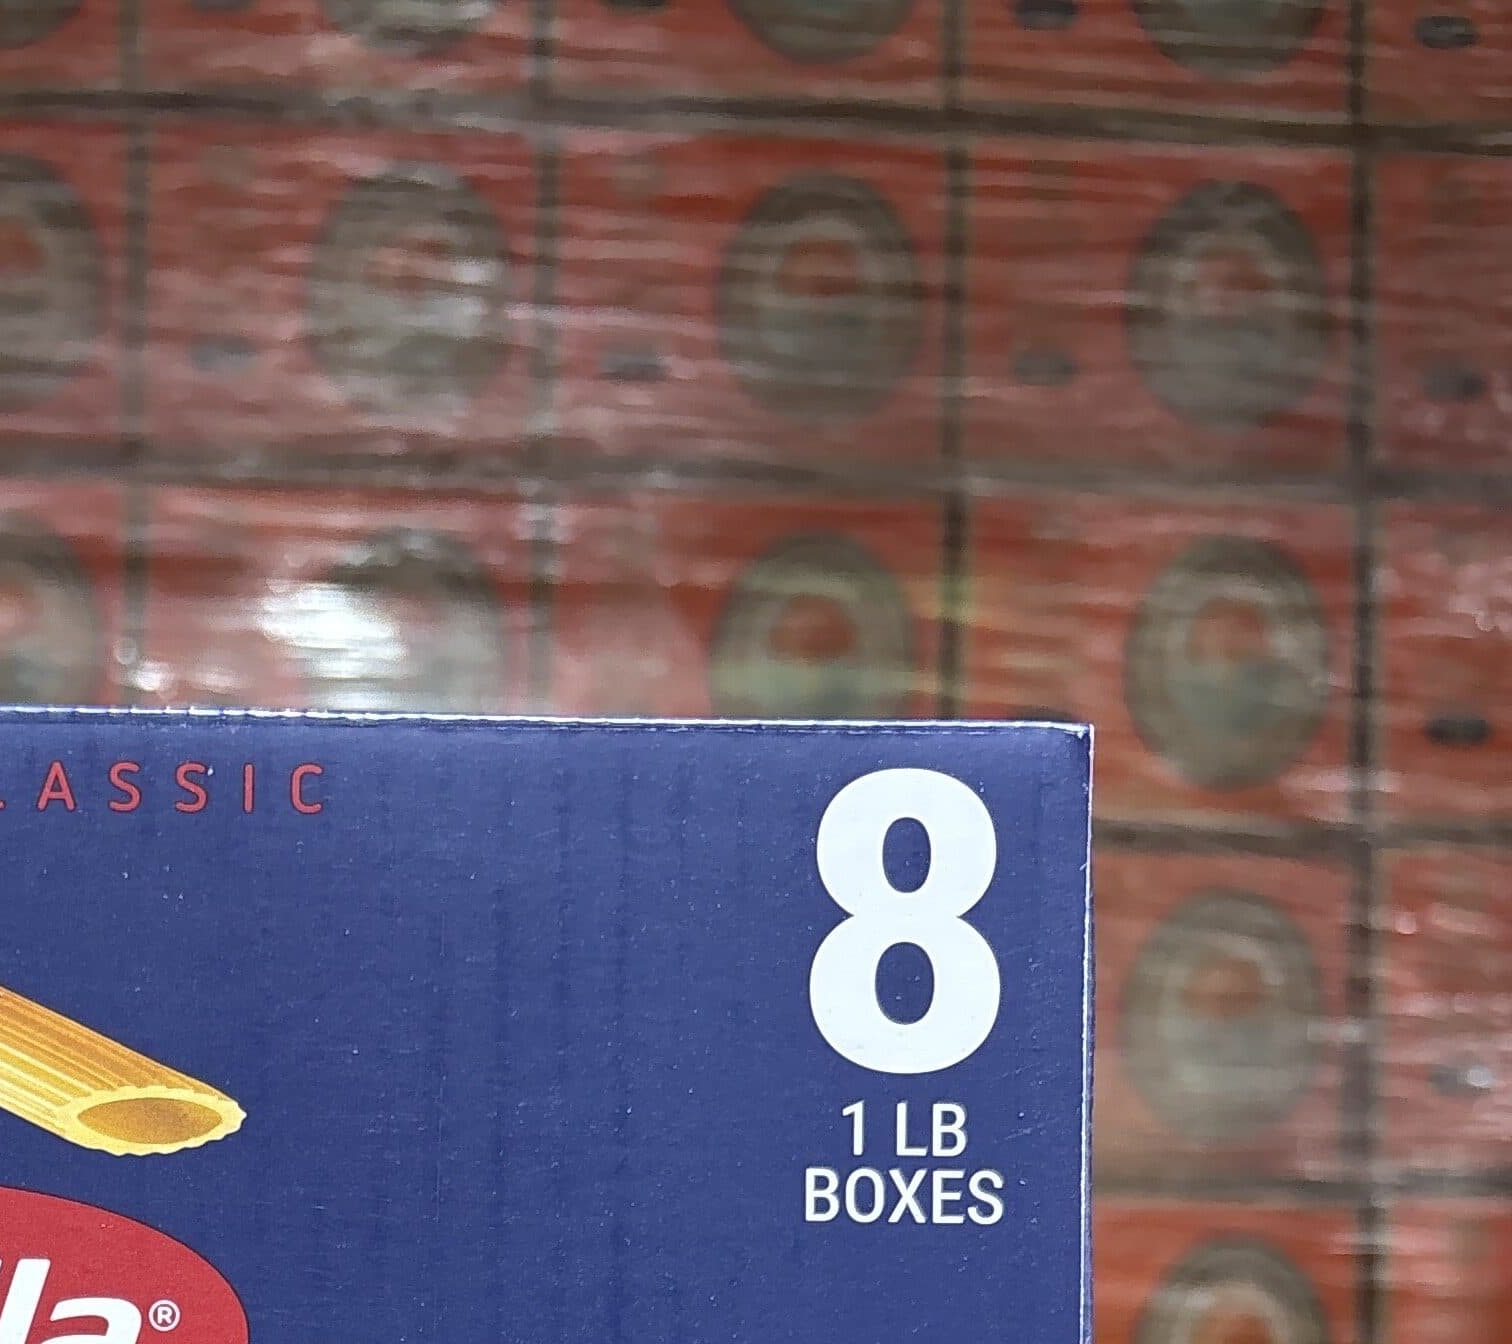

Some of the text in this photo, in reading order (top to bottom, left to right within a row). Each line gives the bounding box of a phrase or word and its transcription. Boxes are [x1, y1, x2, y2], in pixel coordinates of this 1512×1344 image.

[809, 767, 1001, 1074] 8
[841, 1100, 968, 1157] 1 LB
[805, 1166, 1004, 1225] BOXES
